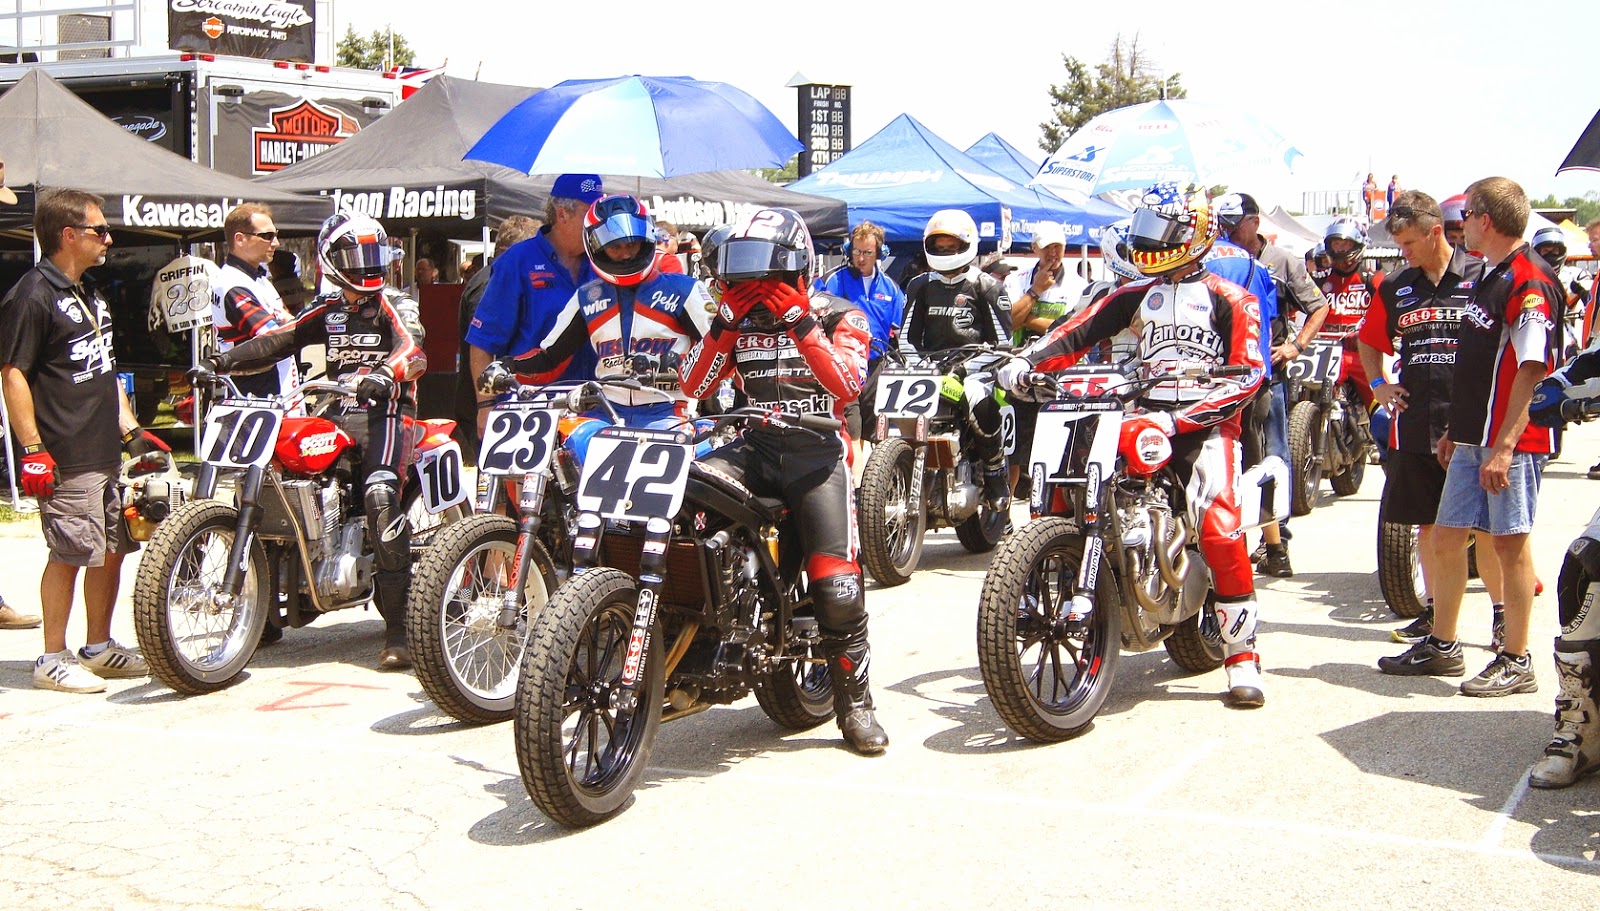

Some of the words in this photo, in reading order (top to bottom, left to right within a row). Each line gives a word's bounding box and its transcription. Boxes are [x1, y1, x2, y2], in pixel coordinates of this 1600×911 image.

[227, 25, 269, 38] PERFORMANCE
[271, 31, 287, 41] PARTS
[811, 86, 831, 99] LAP
[282, 112, 330, 136] MOTOR
[811, 109, 829, 122] 1ST
[811, 123, 829, 136] 2ND
[811, 137, 829, 150] 3RD
[811, 151, 829, 164] 4TH
[816, 170, 944, 186] TRIUMPH
[122, 195, 244, 228] Kawasak
[320, 188, 384, 219] dson
[387, 185, 476, 220] Racing
[645, 196, 723, 226] -Davidson
[160, 264, 204, 283] GRIFFIN
[166, 279, 210, 317] 23
[651, 291, 680, 313] Jeff
[1326, 291, 1372, 308] AGGIO
[928, 306, 972, 317] SHIFT
[180, 320, 190, 330] GOD
[1141, 321, 1221, 360] Zanotti
[603, 357, 624, 369] Raci
[878, 379, 936, 414] 12
[942, 381, 962, 400] Kawasa
[207, 410, 277, 464] 10
[483, 410, 551, 470] 23
[1049, 414, 1102, 478] 1
[423, 450, 460, 508] 10
[582, 441, 685, 517] 42
[1257, 472, 1274, 525] 1
[624, 591, 652, 679] CROSLEY
[643, 632, 652, 651] TODAY
